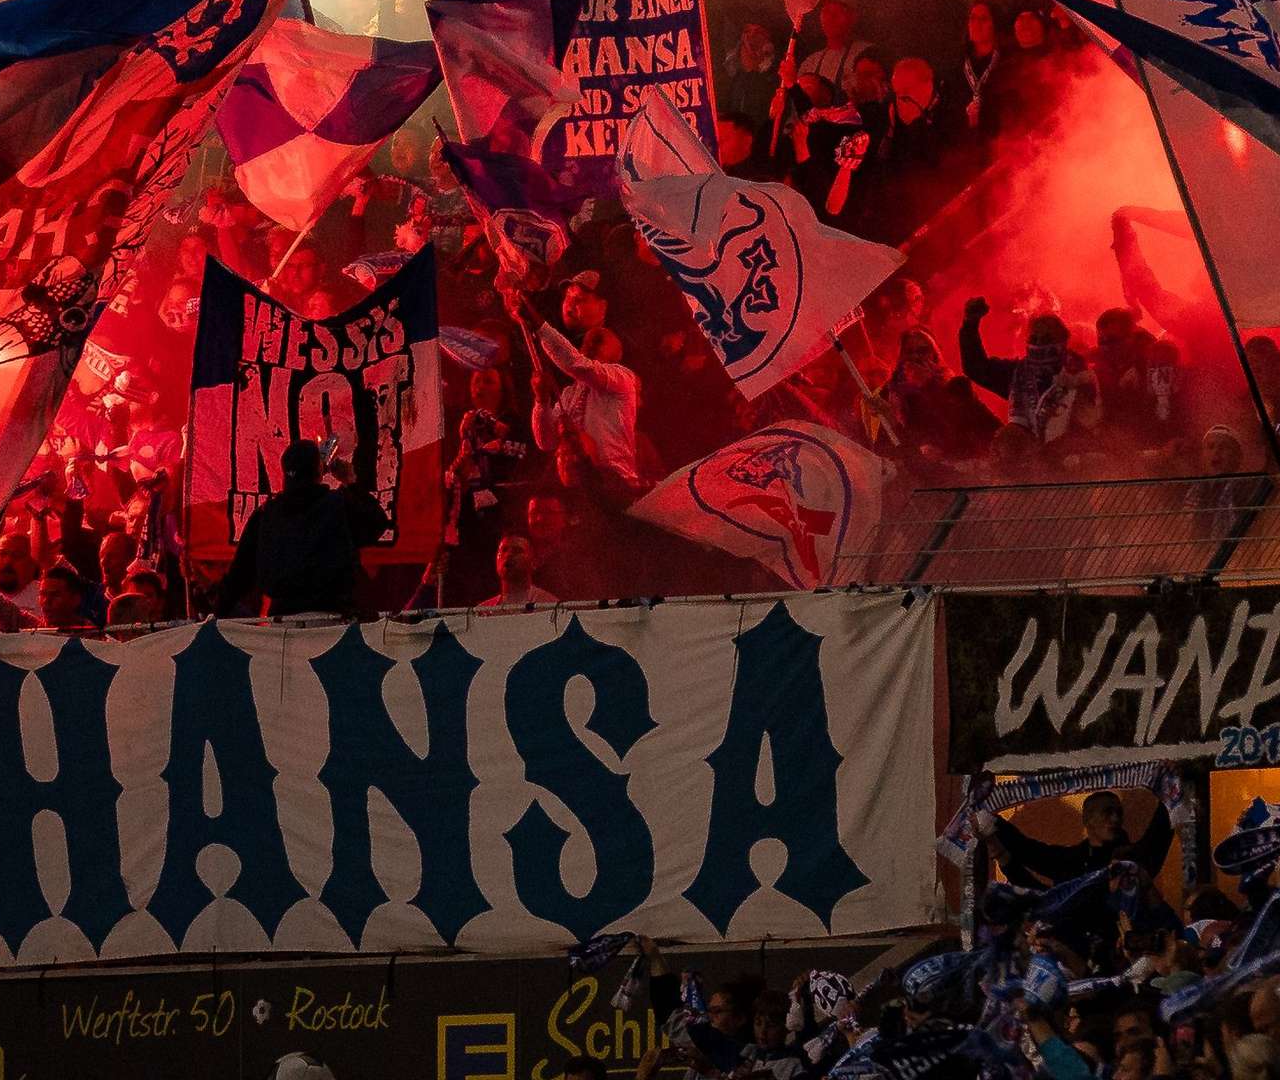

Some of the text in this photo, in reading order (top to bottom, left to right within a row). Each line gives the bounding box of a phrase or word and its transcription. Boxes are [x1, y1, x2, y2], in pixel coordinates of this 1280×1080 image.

[562, 28, 697, 77] HANSA
[573, 89, 613, 116] ND
[234, 354, 410, 494] NOT
[62, 985, 391, 1045] Werftstr. 50 Rostock
